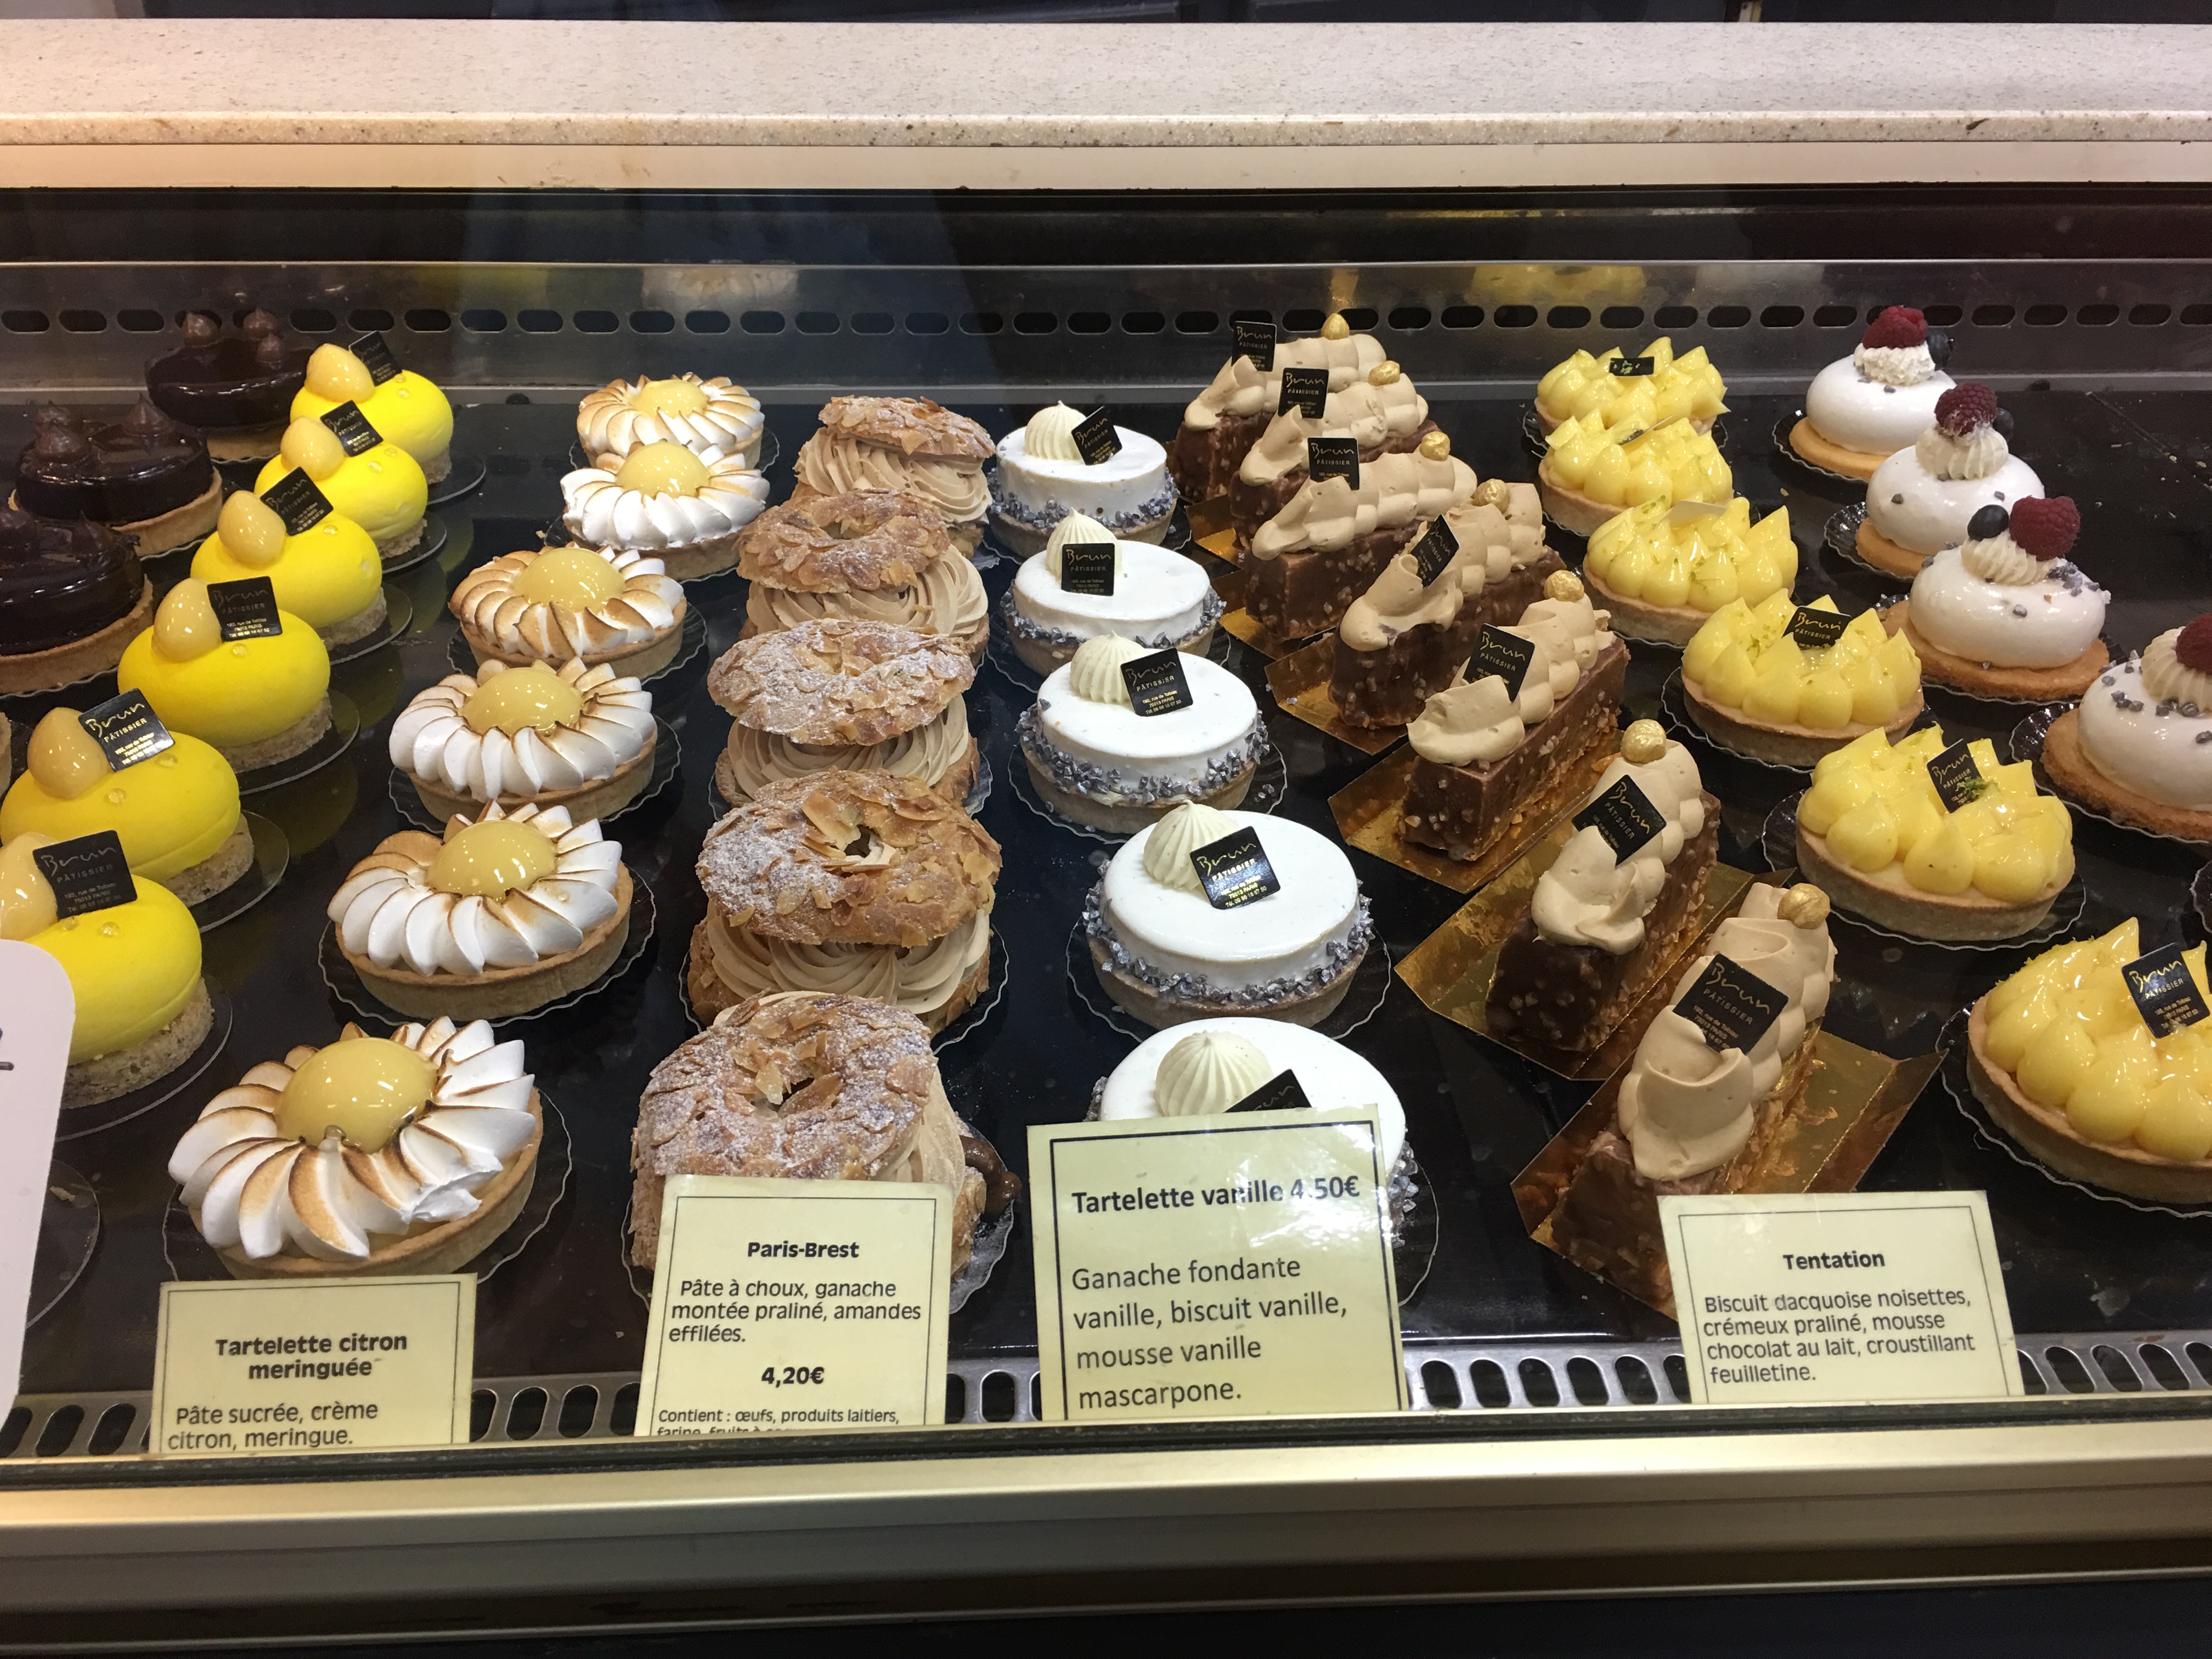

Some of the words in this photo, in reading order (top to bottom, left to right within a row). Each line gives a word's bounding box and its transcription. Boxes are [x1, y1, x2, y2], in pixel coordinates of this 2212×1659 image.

[1066, 549, 1111, 566] Brun
[1126, 661, 1176, 686] Brun
[1197, 843, 1256, 877] Brun
[1706, 962, 1770, 1014] Brun
[1254, 1086, 1294, 1111] run
[1071, 1187, 1195, 1214] Tartelette
[1201, 1180, 1284, 1205] vanille
[747, 1240, 860, 1259] Paris-Brest
[1782, 1250, 1886, 1270] Tentation
[1072, 1262, 1181, 1290] Ganache
[1188, 1256, 1301, 1283] fondante
[680, 1278, 724, 1297] Pâte
[728, 1278, 740, 1297] à
[745, 1280, 808, 1300] choux,
[815, 1280, 896, 1299] ganache
[1704, 1294, 1769, 1313] Biscuit
[1774, 1291, 1872, 1312] dacquoise
[1877, 1288, 1971, 1307] noisettes,
[672, 1301, 750, 1320] montée
[755, 1301, 827, 1322] praliné,
[833, 1302, 921, 1320] amandes
[1073, 1302, 1162, 1330] vanille,
[1170, 1296, 1252, 1324] biscuit
[1258, 1290, 1347, 1318] vanille,
[668, 1324, 746, 1342] effilées.
[1703, 1317, 1790, 1337] crémeux
[1793, 1313, 1867, 1336] praliné,
[1872, 1314, 1945, 1330] mousse
[215, 1335, 332, 1356] Tartelette
[338, 1333, 408, 1352] citron
[1077, 1346, 1173, 1369] mousse
[1180, 1334, 1261, 1362] vanille
[1707, 1340, 1792, 1360] chocolat
[1796, 1342, 1820, 1357] au
[1825, 1337, 1861, 1357] lait,
[1866, 1333, 1976, 1355] croustillant
[248, 1357, 373, 1380] meringuée
[760, 1366, 825, 1389] 4,20€
[1710, 1363, 1816, 1384] feuilletine.
[1079, 1383, 1242, 1409] mascarpone.
[176, 1405, 223, 1425] Pâte
[228, 1402, 303, 1424] sucrée,
[311, 1400, 379, 1421] crème
[659, 1409, 724, 1423] Contient
[735, 1408, 776, 1424] œufs,
[781, 1408, 844, 1424] produits
[848, 1408, 899, 1425] laitiers,
[168, 1431, 236, 1451] citron,
[245, 1427, 352, 1448] meringue.
